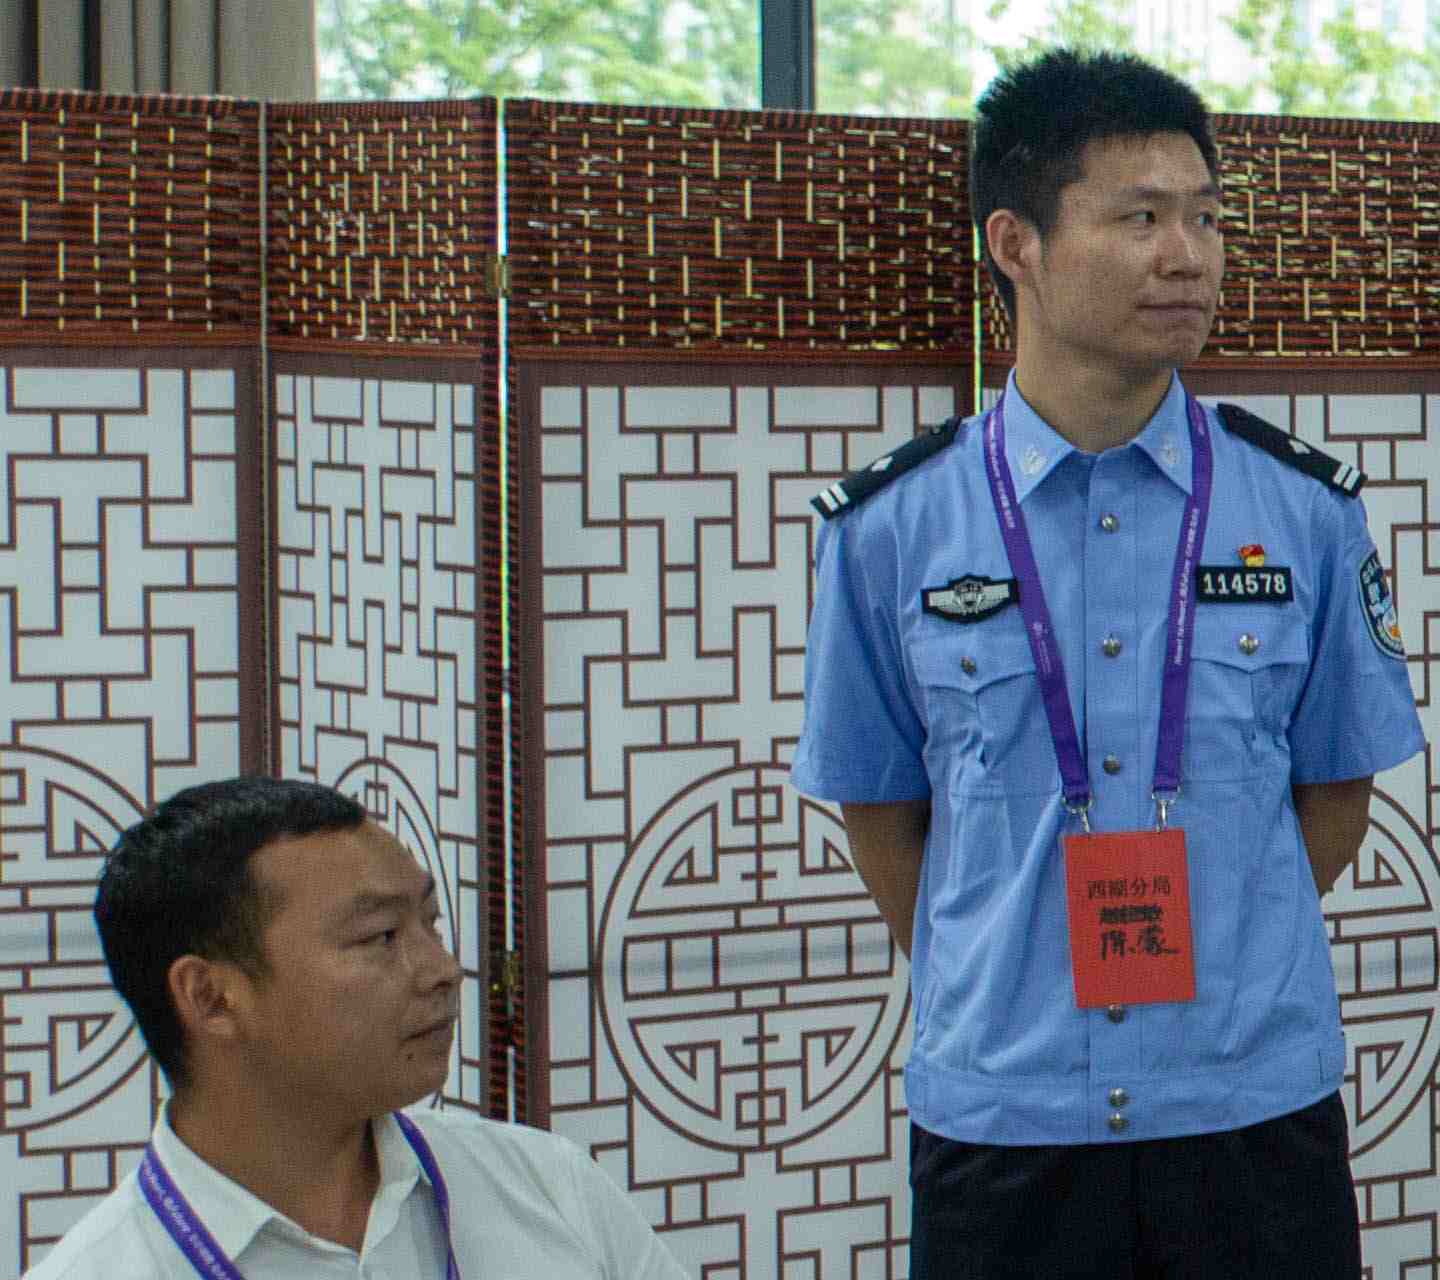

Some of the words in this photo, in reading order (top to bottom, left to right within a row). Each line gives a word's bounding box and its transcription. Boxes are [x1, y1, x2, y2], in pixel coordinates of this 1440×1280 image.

[1203, 572, 1287, 595] 114578
[1087, 875, 1172, 900] 西湖分局
